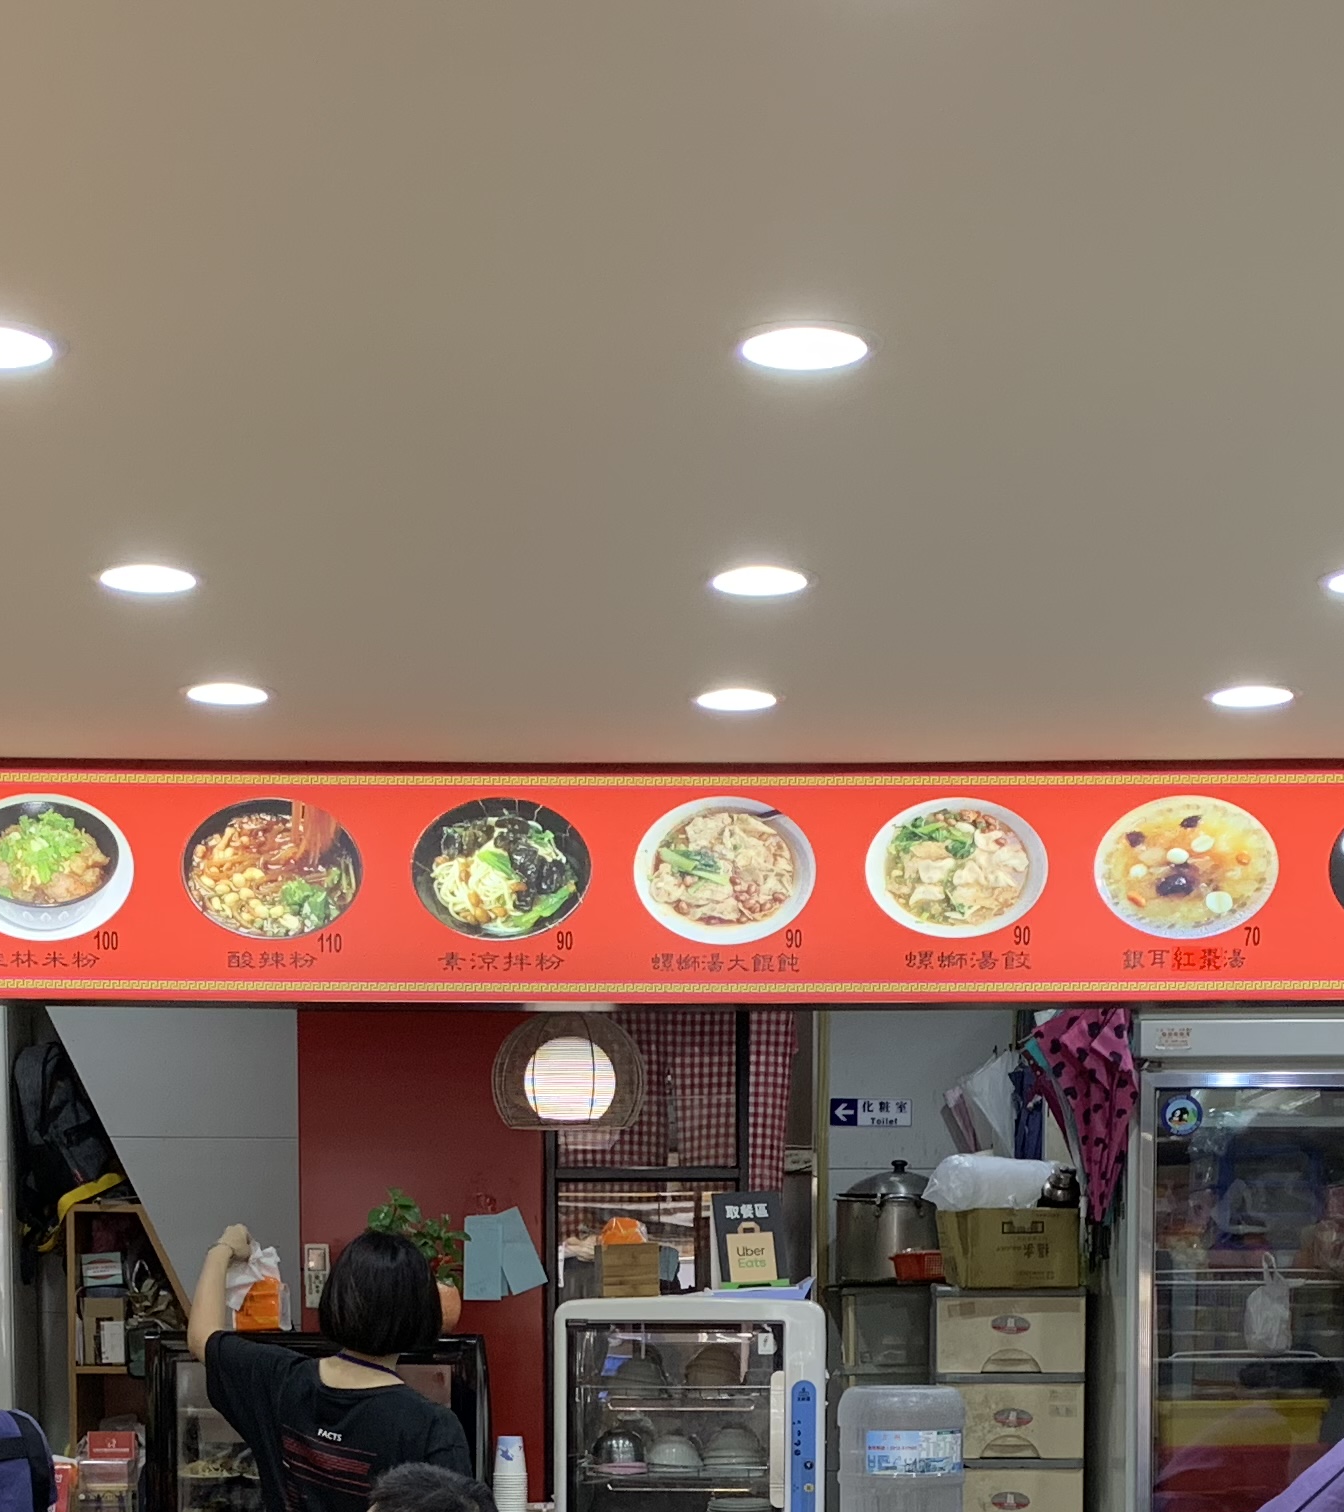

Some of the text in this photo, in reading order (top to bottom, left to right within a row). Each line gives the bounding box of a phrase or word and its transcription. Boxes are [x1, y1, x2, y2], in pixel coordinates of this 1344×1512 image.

[93, 930, 119, 951] 100
[317, 933, 343, 953] 110
[556, 930, 574, 951] 90
[785, 928, 802, 949] 90
[1013, 925, 1031, 947] 90
[1244, 926, 1261, 947] 70
[226, 951, 318, 970] 酸辣粉
[437, 951, 565, 971] 素涼拌粉
[870, 1117, 898, 1125] Toilet
[725, 1203, 769, 1219] 取餐區
[736, 1246, 765, 1257] Uber
[738, 1259, 767, 1268] Eats
[317, 1428, 343, 1442] FACTS
